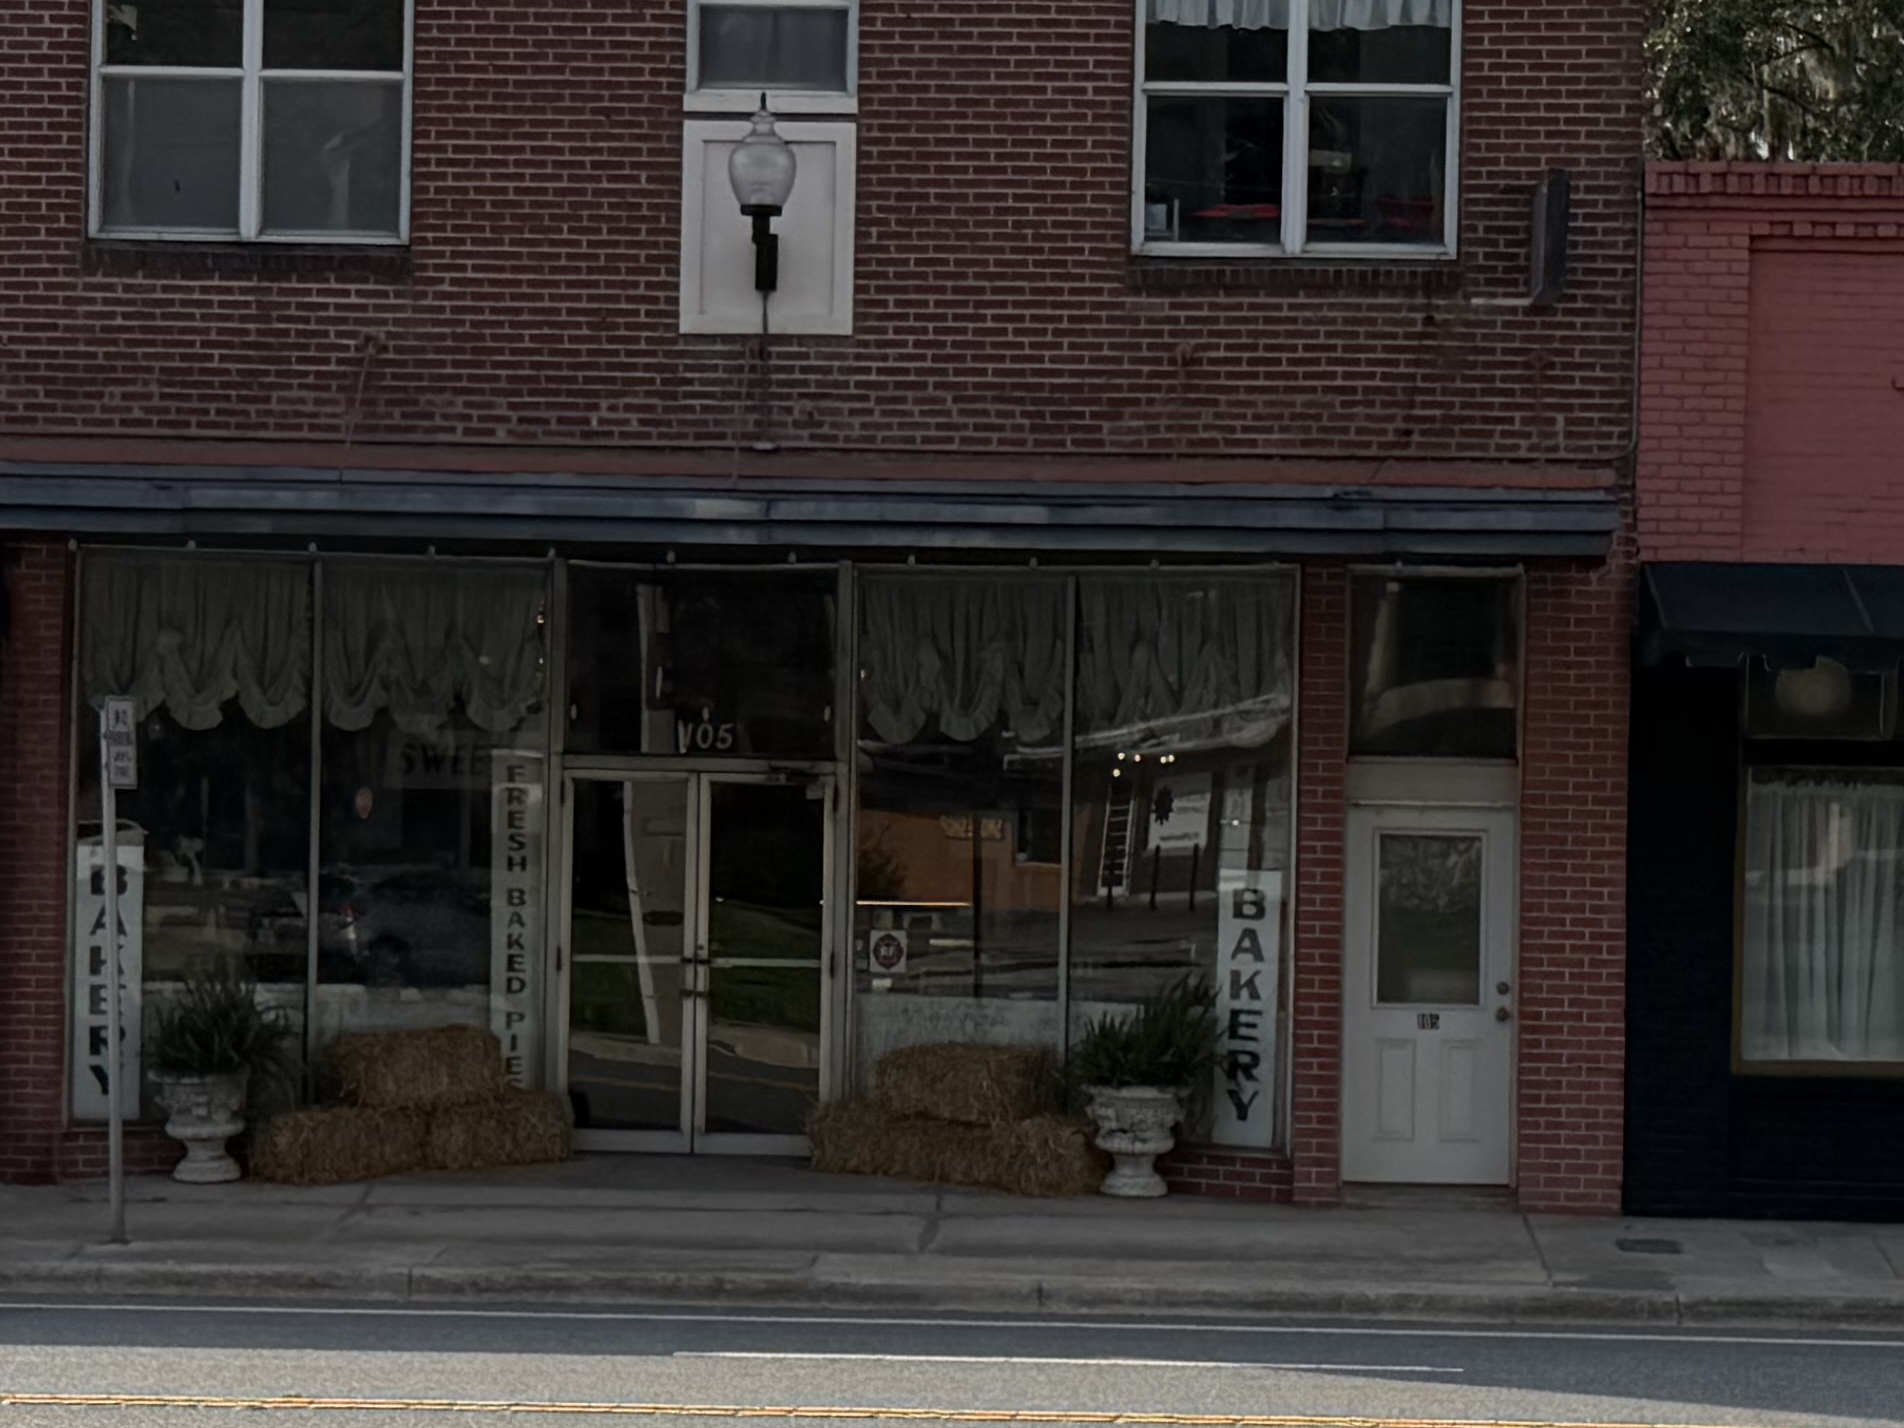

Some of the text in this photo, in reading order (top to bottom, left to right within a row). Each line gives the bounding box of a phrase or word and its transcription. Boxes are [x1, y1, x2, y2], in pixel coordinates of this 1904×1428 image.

[401, 744, 491, 775] SWEE
[505, 764, 528, 872] FRESH
[505, 887, 528, 995] BAKED
[1226, 887, 1266, 1121] BAKERY
